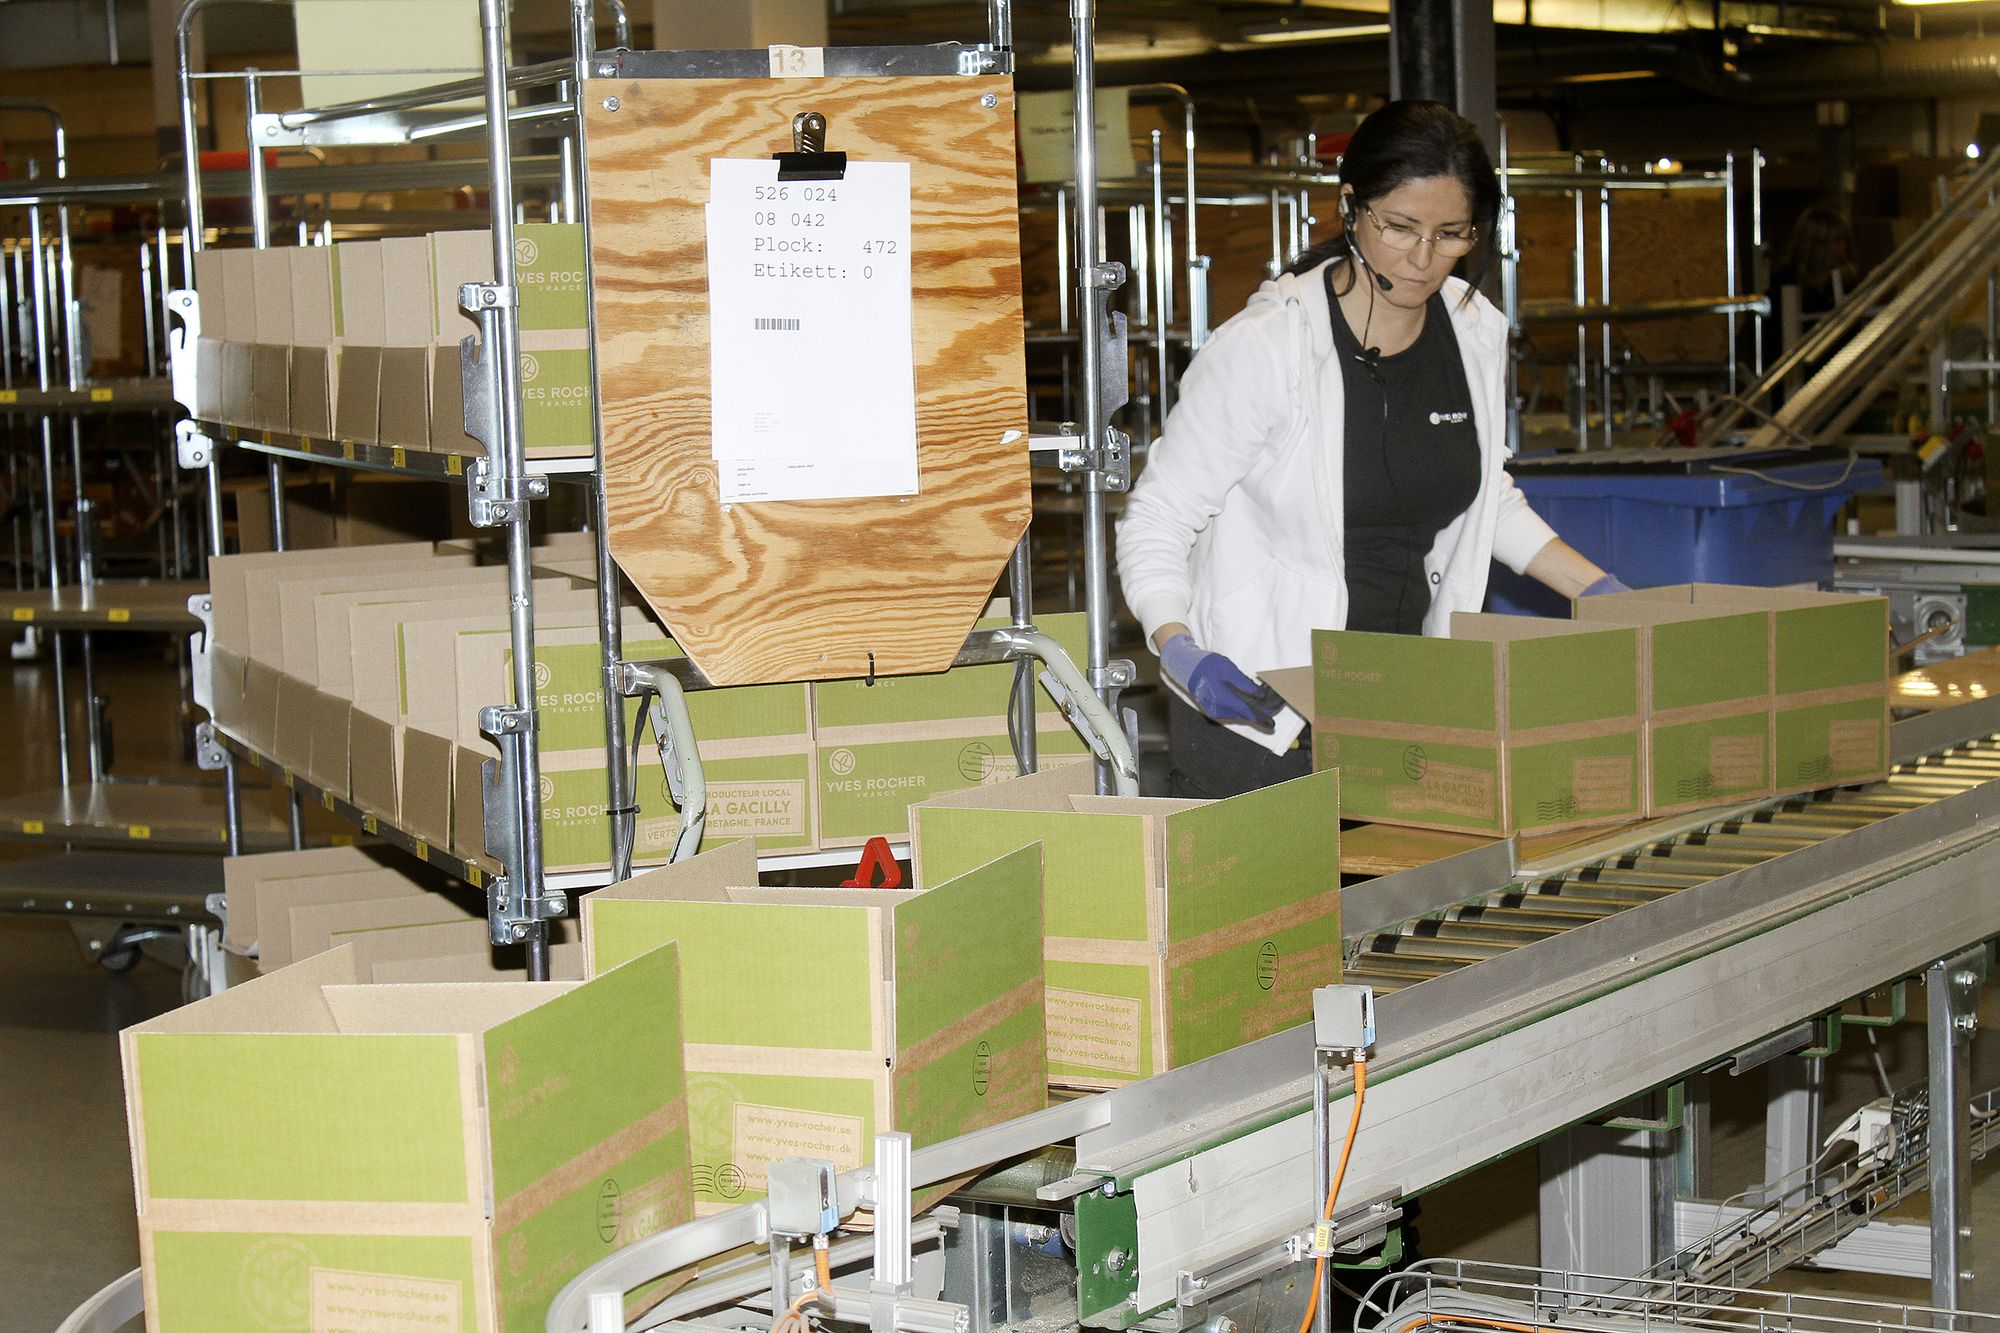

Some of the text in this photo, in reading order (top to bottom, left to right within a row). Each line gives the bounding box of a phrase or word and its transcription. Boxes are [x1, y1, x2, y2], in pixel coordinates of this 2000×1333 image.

[754, 186, 838, 202] 526 024
[754, 211, 825, 227] 08 042
[754, 236, 897, 254] Plock: 472
[516, 270, 583, 284] VES ROC
[754, 262, 873, 280] Etikett: 0
[825, 775, 927, 793] YVES ROCHER
[706, 788, 792, 799] RODUCTEUR LOCAL
[726, 800, 791, 815] GACILLY
[706, 817, 791, 828] RETAGNE, FRANCE
[647, 829, 677, 840] VERTS
[746, 1114, 852, 1136] www.yves-rocher.se
[746, 1133, 853, 1155] www.yves-rocher.dk
[325, 1282, 448, 1302] www.yves-rocher.se
[325, 1303, 449, 1325] www.yves-rocher.dk
